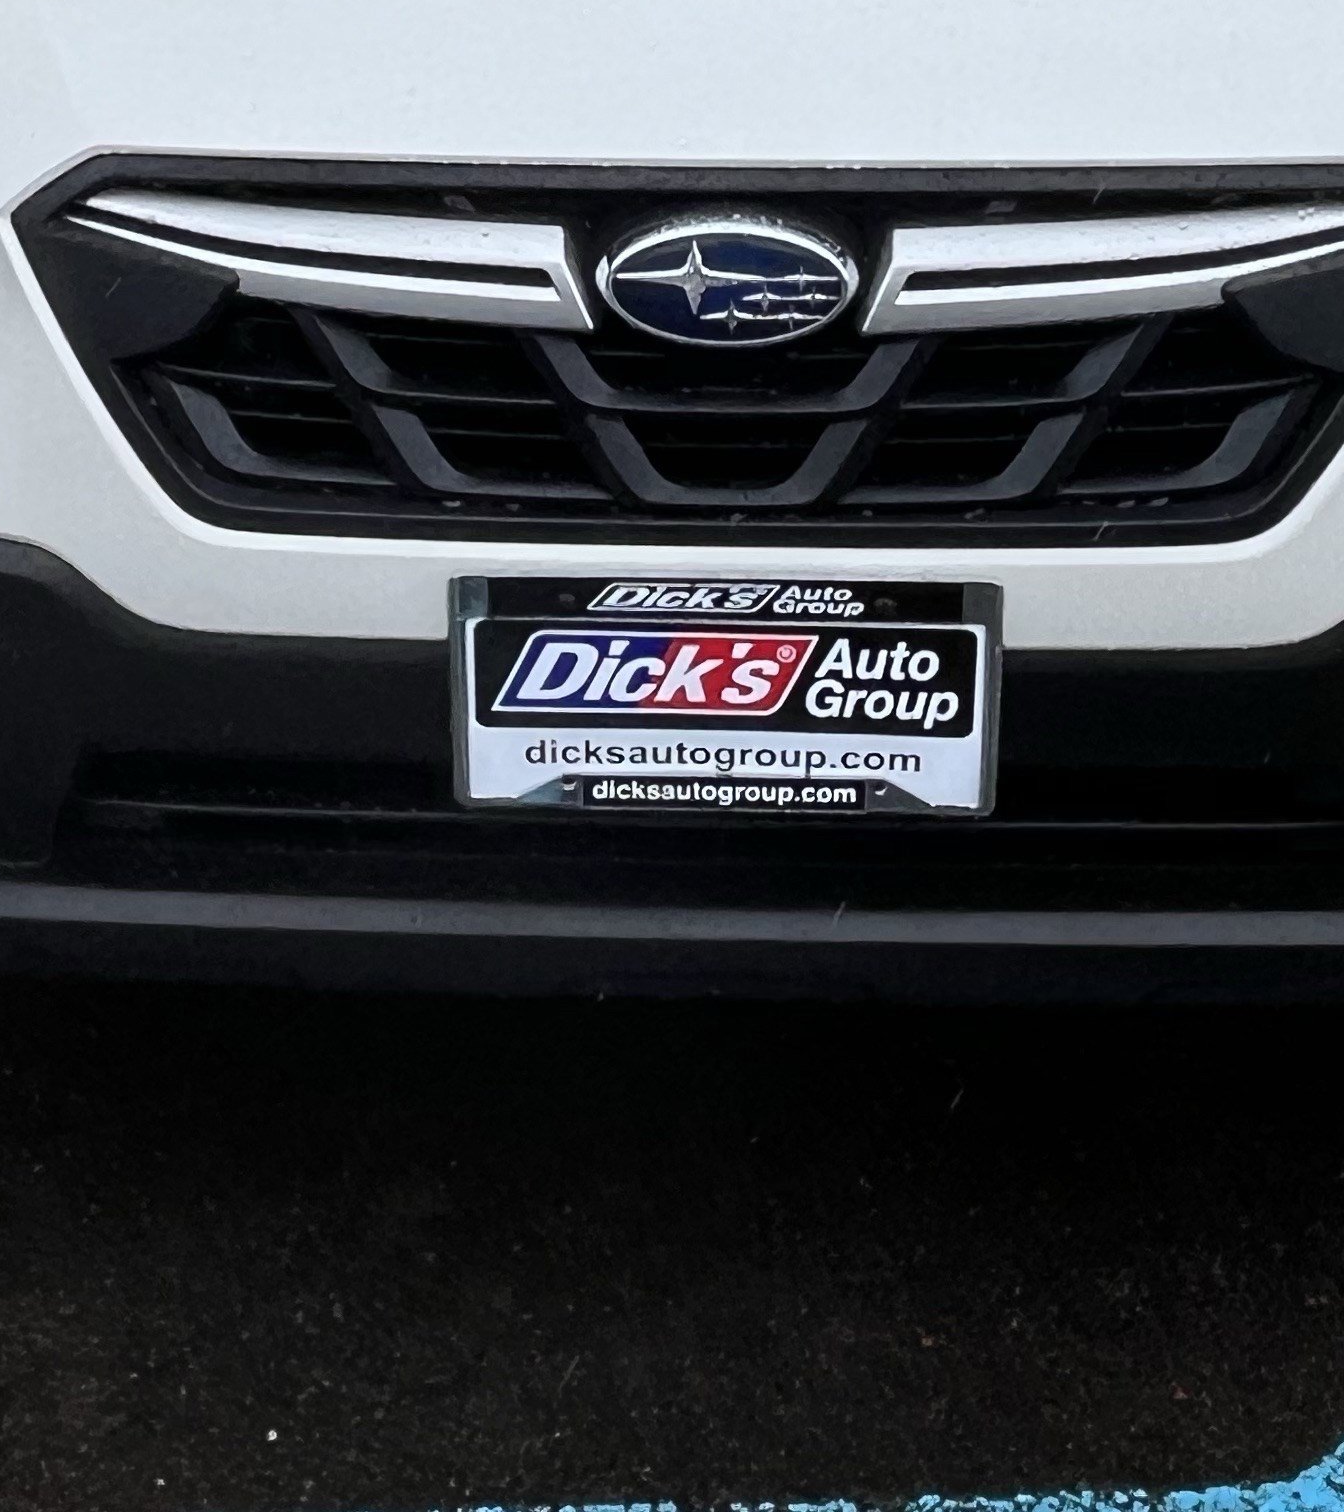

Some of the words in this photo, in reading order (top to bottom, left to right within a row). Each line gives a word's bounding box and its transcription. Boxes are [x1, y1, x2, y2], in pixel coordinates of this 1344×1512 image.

[602, 584, 764, 610] Dick's
[780, 585, 853, 602] Auto
[773, 599, 865, 618] Group
[516, 640, 780, 705] Dick's
[814, 638, 940, 681] Auto
[805, 679, 959, 730] Group
[524, 739, 921, 778] dicksautogroup.com
[592, 779, 857, 806] dicksautogroup.com
